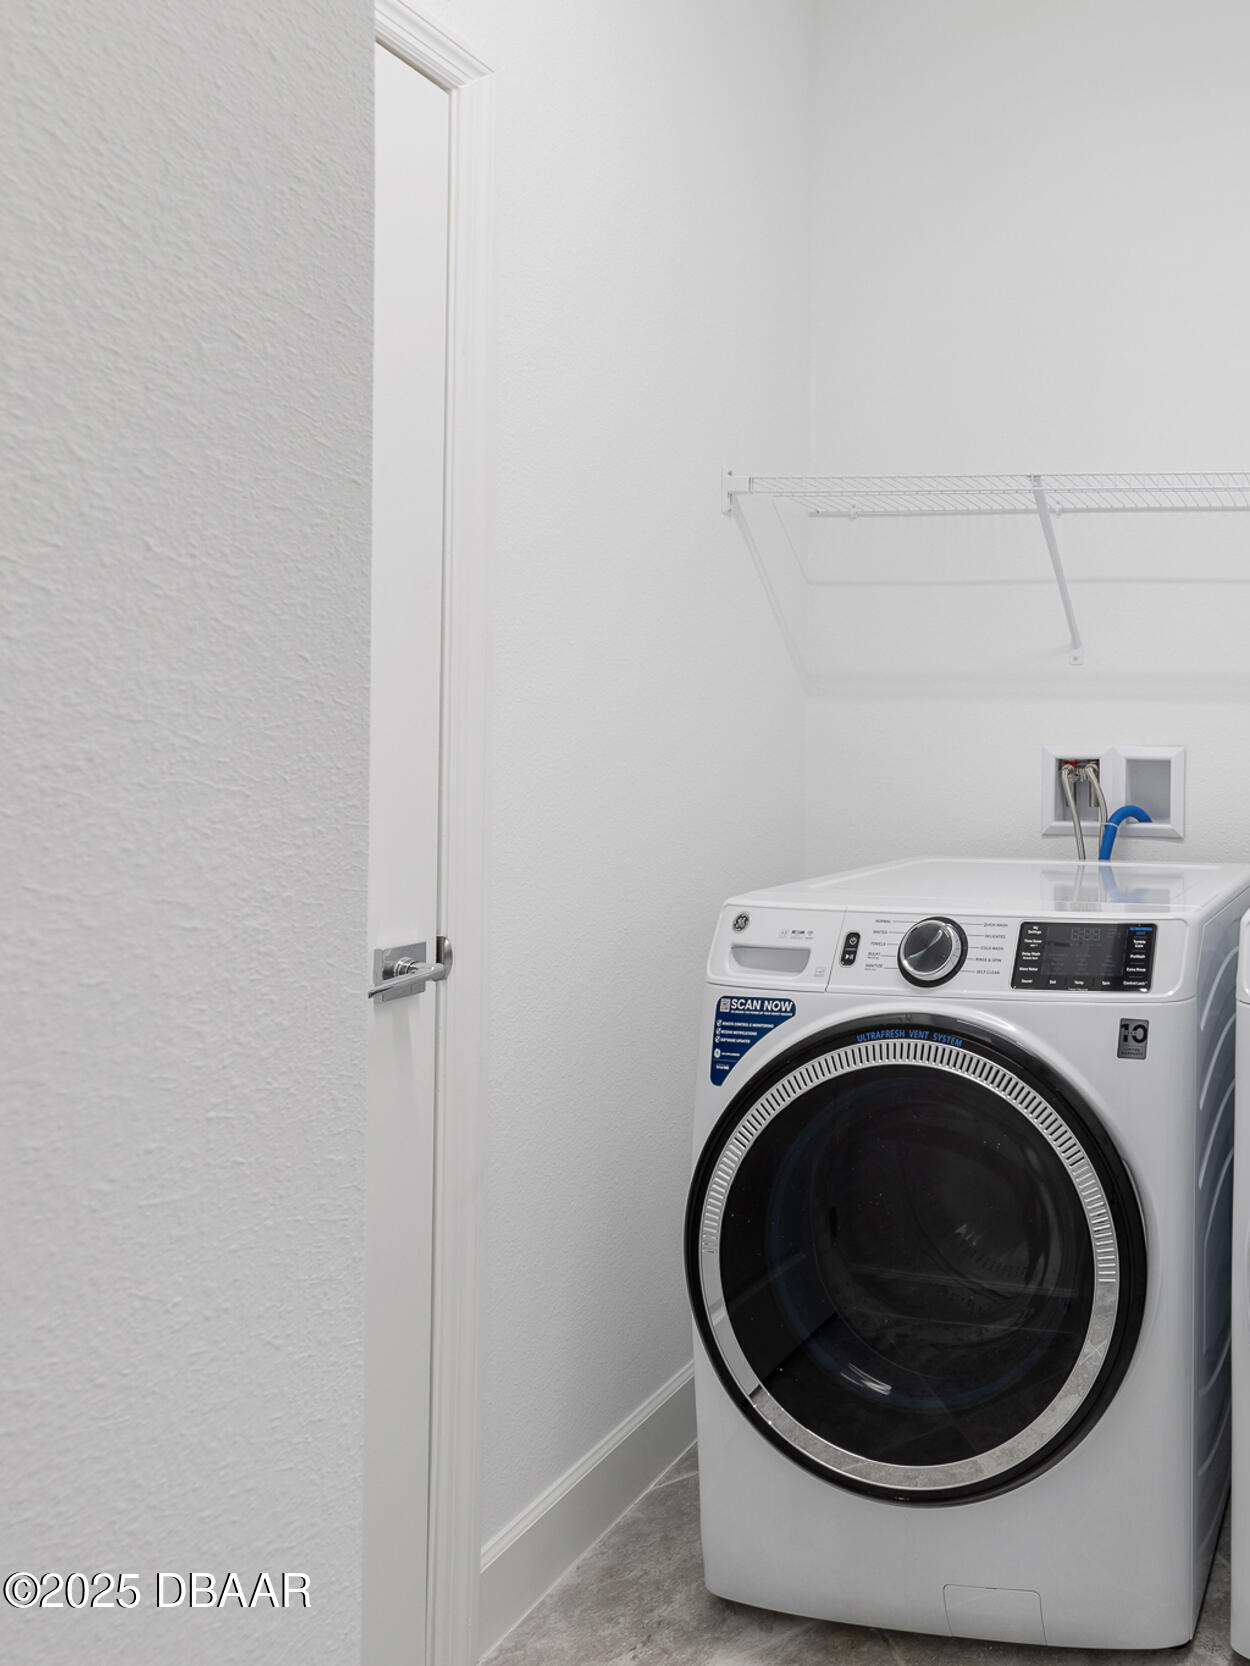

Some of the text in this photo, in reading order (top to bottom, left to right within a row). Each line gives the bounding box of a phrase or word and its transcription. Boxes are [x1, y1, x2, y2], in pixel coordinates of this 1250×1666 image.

[730, 998, 793, 1011] SCAN NOW
[856, 1029, 963, 1047] ULTRAFRESH VENT SYSTEM
[1120, 1023, 1147, 1044] 10
